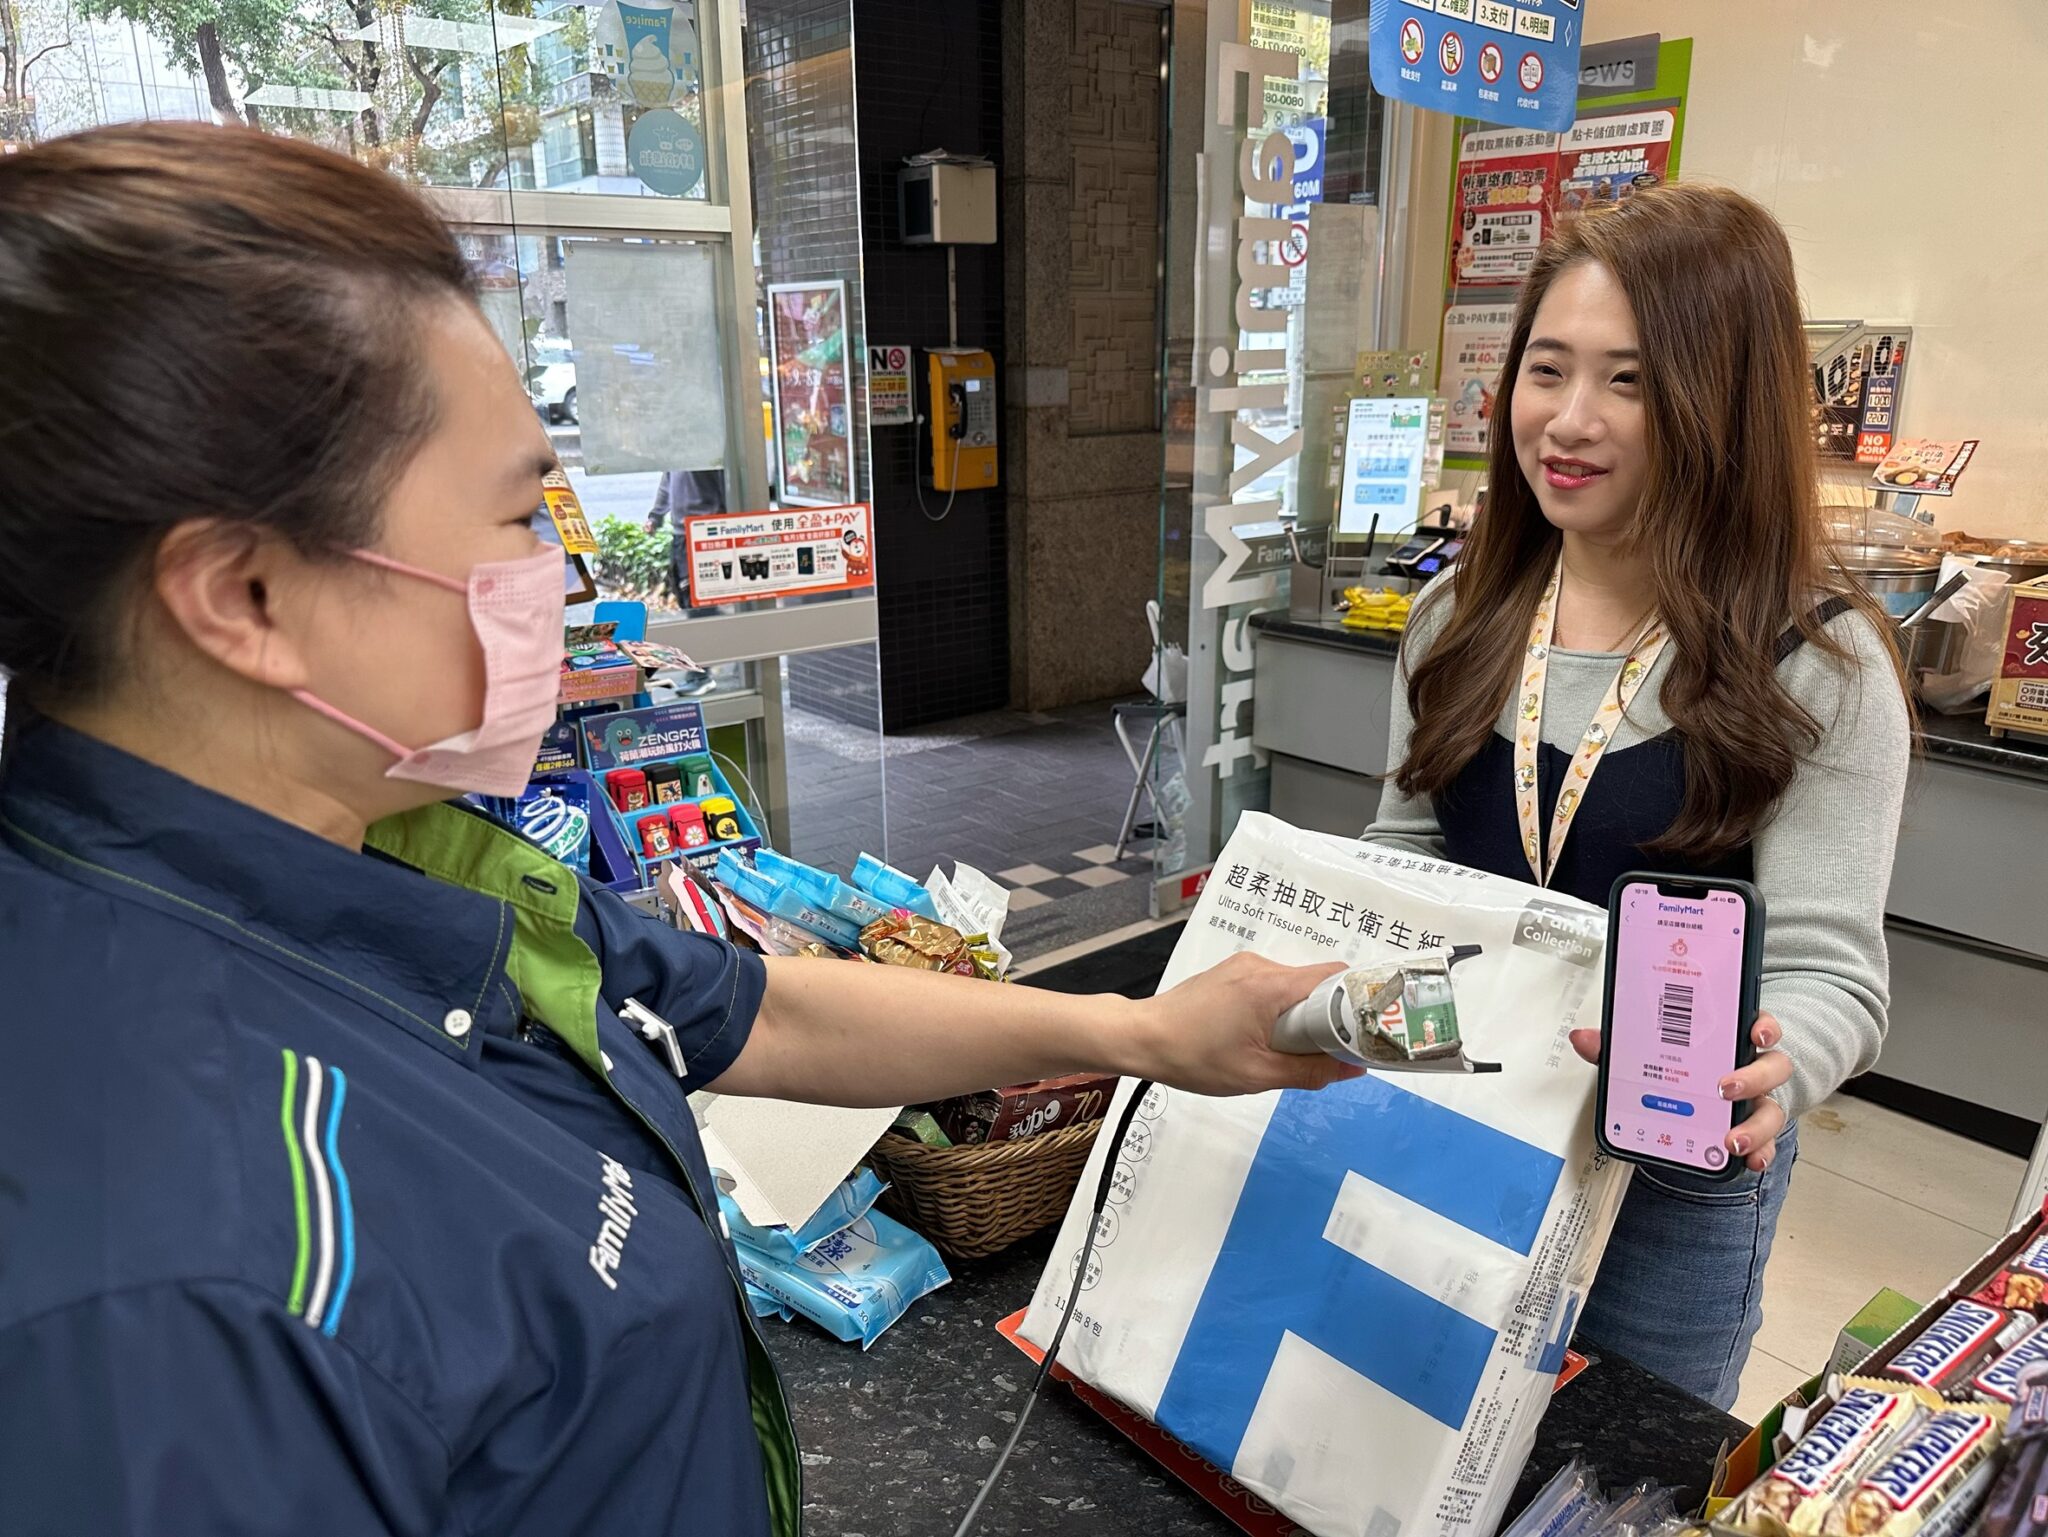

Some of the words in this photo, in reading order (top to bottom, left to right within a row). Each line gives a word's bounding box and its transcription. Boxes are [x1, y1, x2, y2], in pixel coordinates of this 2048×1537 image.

[1480, 5, 1509, 26] 3.支付
[1520, 15, 1549, 36] 4.明細
[1582, 60, 1634, 84] ews
[1857, 446, 1887, 455] PORK
[1863, 435, 1884, 446] NO
[720, 523, 765, 536] FamilyMart
[772, 517, 794, 531] 使用
[1258, 540, 1325, 563] FamiMar
[638, 727, 699, 747] ZENGAZ
[1356, 850, 1489, 881] 超柔抽取式衛生紙
[1225, 863, 1446, 951] 超柔抽取式衛生紙
[1658, 902, 1704, 915] FamilyMart
[1208, 915, 1257, 942] 超柔軟觸感
[1217, 894, 1241, 912] Ultra
[1241, 902, 1266, 922] Soft
[1267, 912, 1302, 935] Tissue
[1303, 926, 1340, 949] Paper
[1522, 926, 1593, 959] Collection
[1067, 1089, 1103, 1126] 70
[589, 1150, 639, 1290] FamilyMa
[819, 1236, 854, 1260] 潔
[1074, 1254, 1101, 1277] 馬分散
[1054, 1295, 1103, 1337] 11抽8包
[1895, 1302, 1997, 1378] SNICKERS
[1777, 1386, 1887, 1489] SNICKERS
